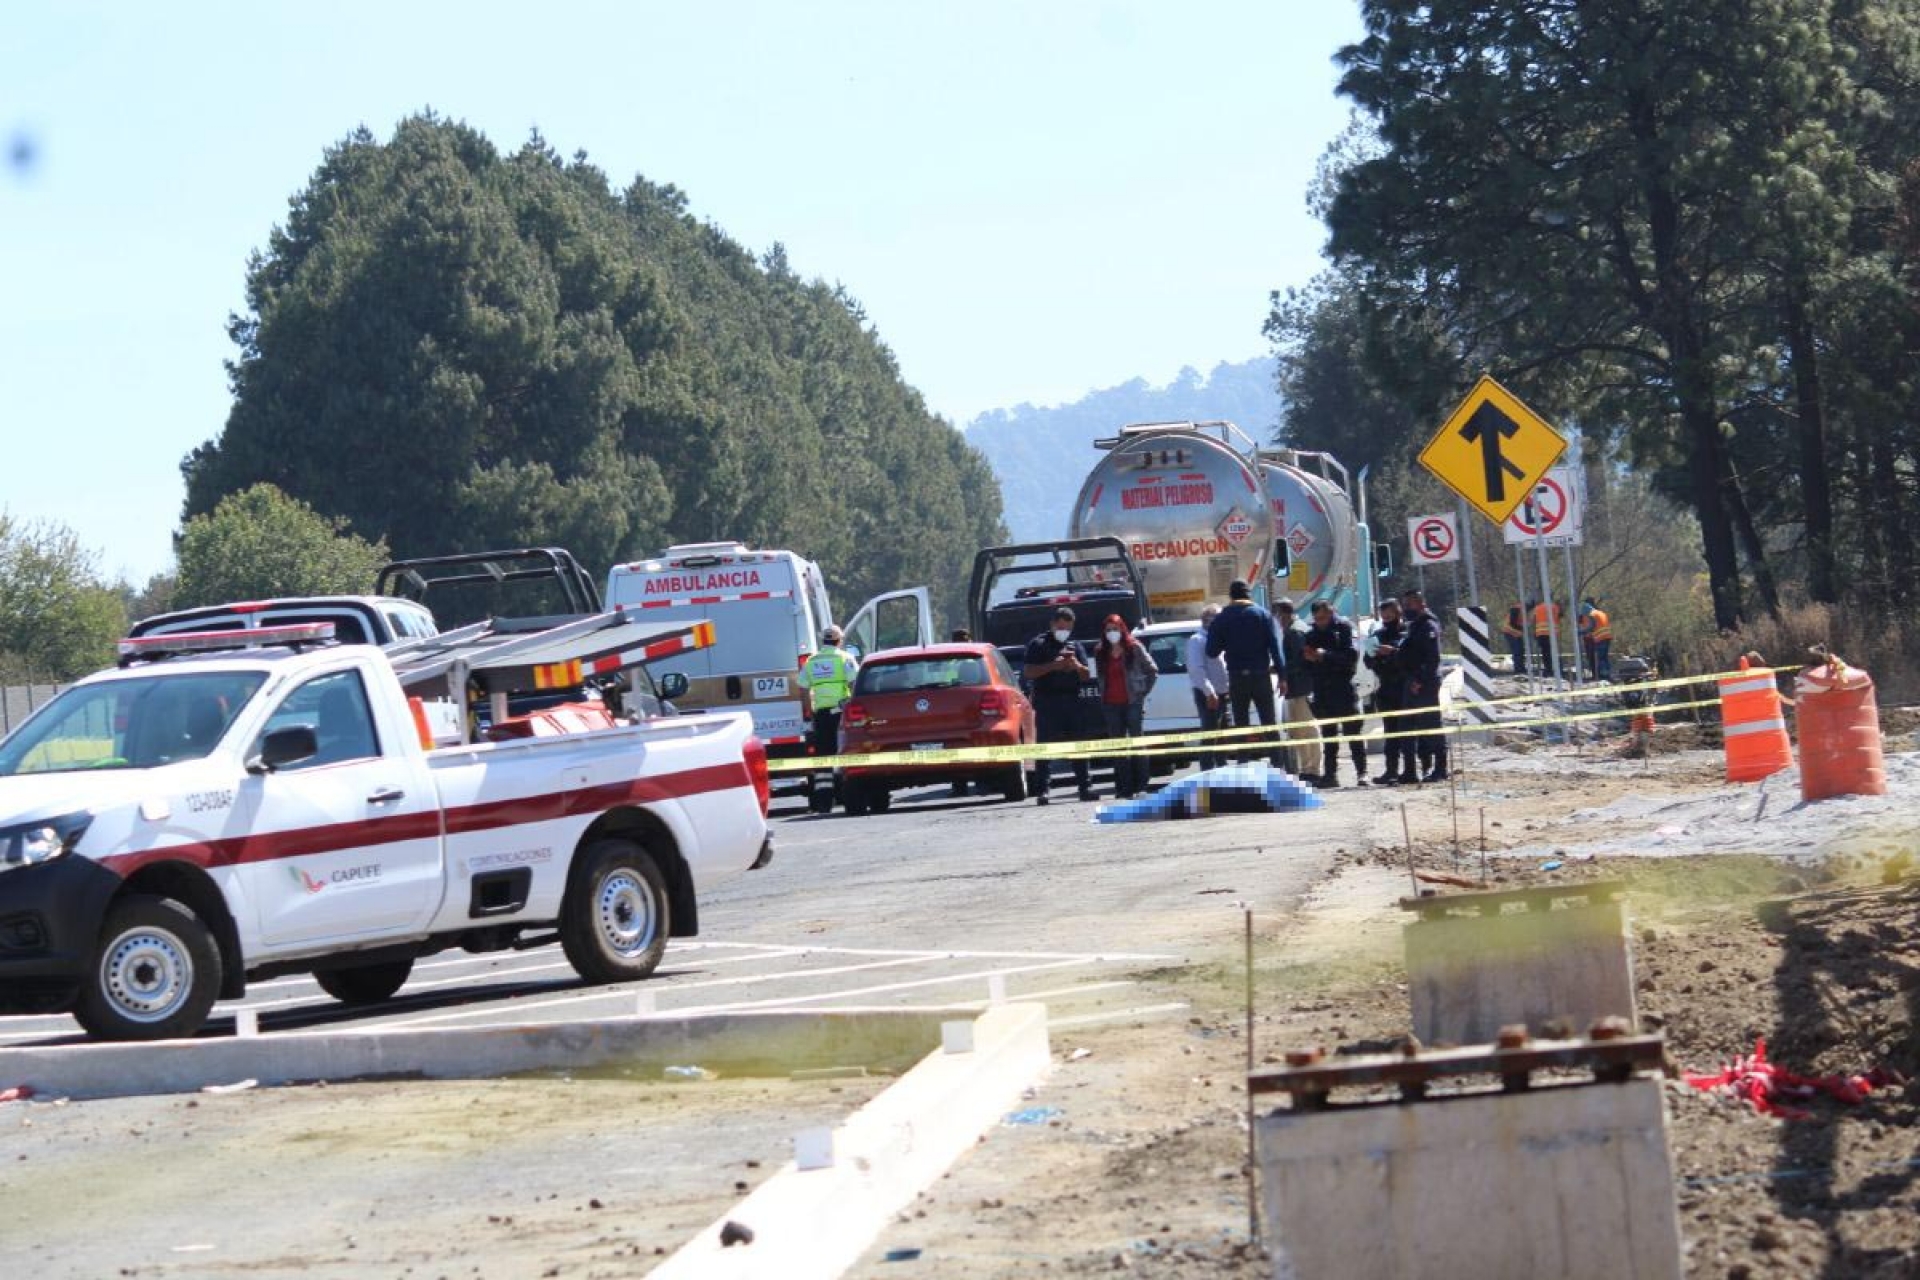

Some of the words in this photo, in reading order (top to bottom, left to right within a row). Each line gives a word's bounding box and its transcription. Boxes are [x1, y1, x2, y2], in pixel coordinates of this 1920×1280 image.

[1126, 536, 1230, 560] RECAUCION
[644, 570, 761, 594] AMBULANCIA
[757, 677, 785, 692] 074
[331, 864, 382, 883] CAPUFE
